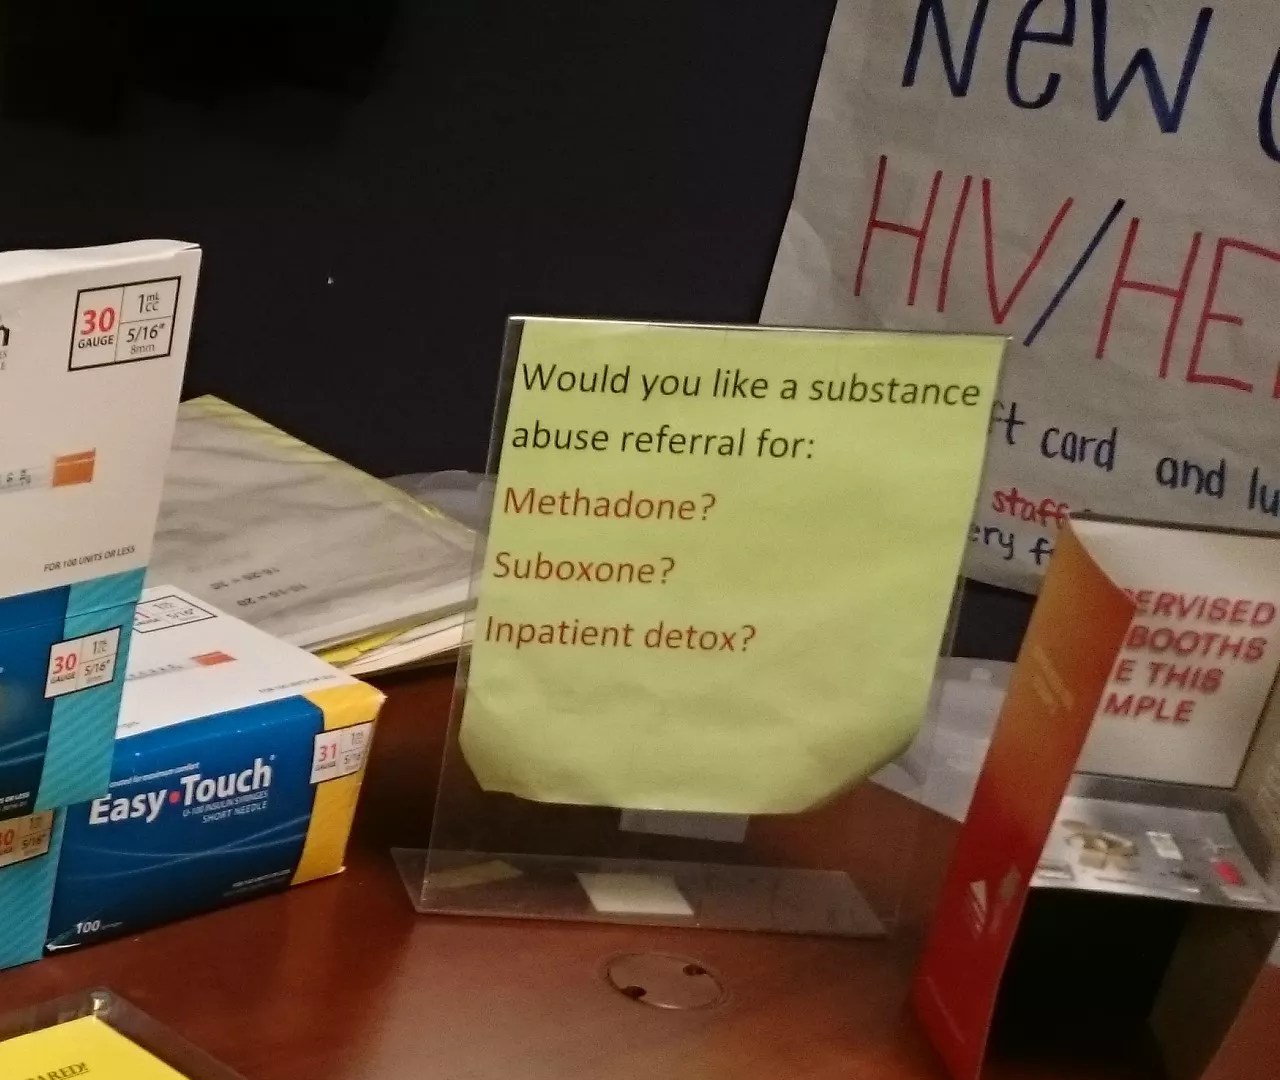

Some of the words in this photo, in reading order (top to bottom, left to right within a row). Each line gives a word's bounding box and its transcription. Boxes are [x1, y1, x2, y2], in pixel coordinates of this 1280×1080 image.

[854, 154, 1280, 400] HIV/HE
[80, 306, 116, 335] 30
[77, 334, 115, 349] GAUGE
[520, 361, 629, 395] Would
[640, 373, 701, 402] you
[711, 367, 769, 400] like
[780, 379, 799, 400] a
[808, 372, 982, 408] substance
[511, 420, 610, 453] abuse
[620, 424, 746, 458] referral
[756, 428, 817, 461] for:
[1040, 426, 1119, 473] card
[1155, 455, 1227, 500] and
[503, 485, 717, 524] Methadone?
[991, 486, 1071, 530] staff
[493, 551, 676, 586] Suboxone?
[485, 615, 635, 651] Inpatient
[644, 622, 757, 653] detox?
[52, 652, 78, 674] 30
[318, 743, 338, 764] 31
